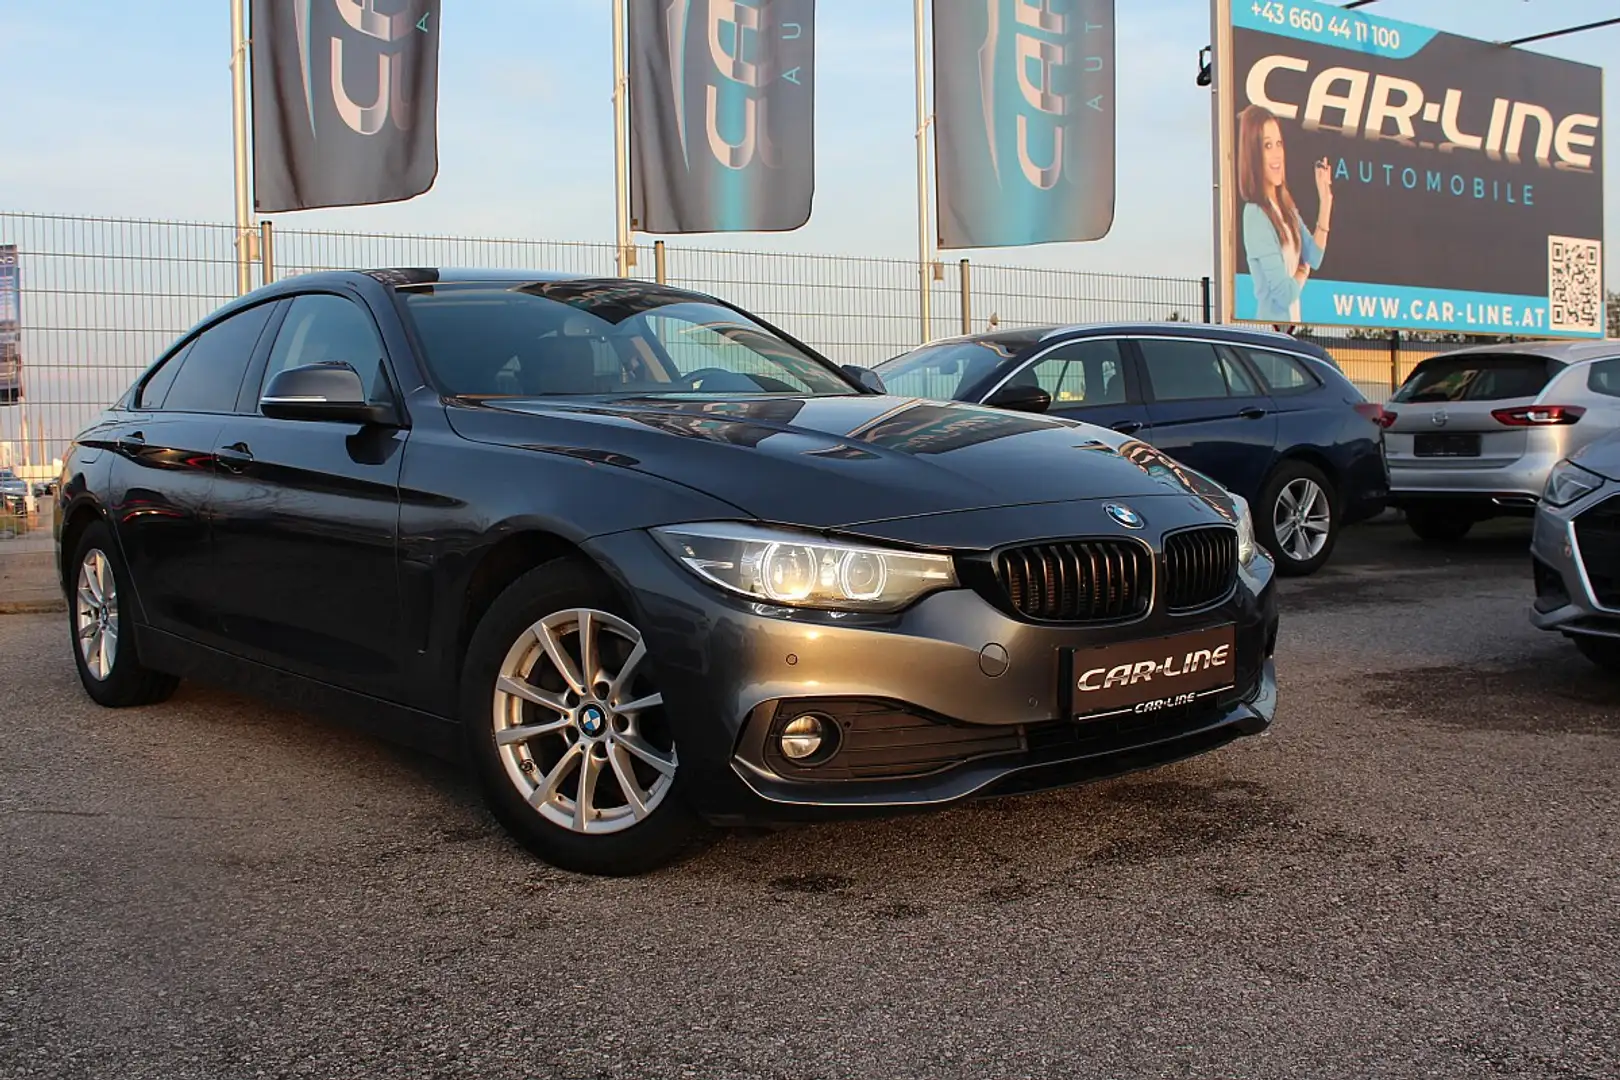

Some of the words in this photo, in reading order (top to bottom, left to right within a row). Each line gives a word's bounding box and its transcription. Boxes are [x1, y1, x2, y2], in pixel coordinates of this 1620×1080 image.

[1251, 0, 1285, 25] +43
[1289, 7, 1323, 33] 660
[1328, 16, 1351, 39] 44
[1355, 20, 1368, 43] 11
[1371, 25, 1400, 49] 100
[781, 22, 801, 85] AU
[1084, 22, 1103, 111] AUT
[1335, 157, 1535, 205] AUTOMOBILE
[1333, 294, 1545, 328] WWW.CAR-LINE.AT
